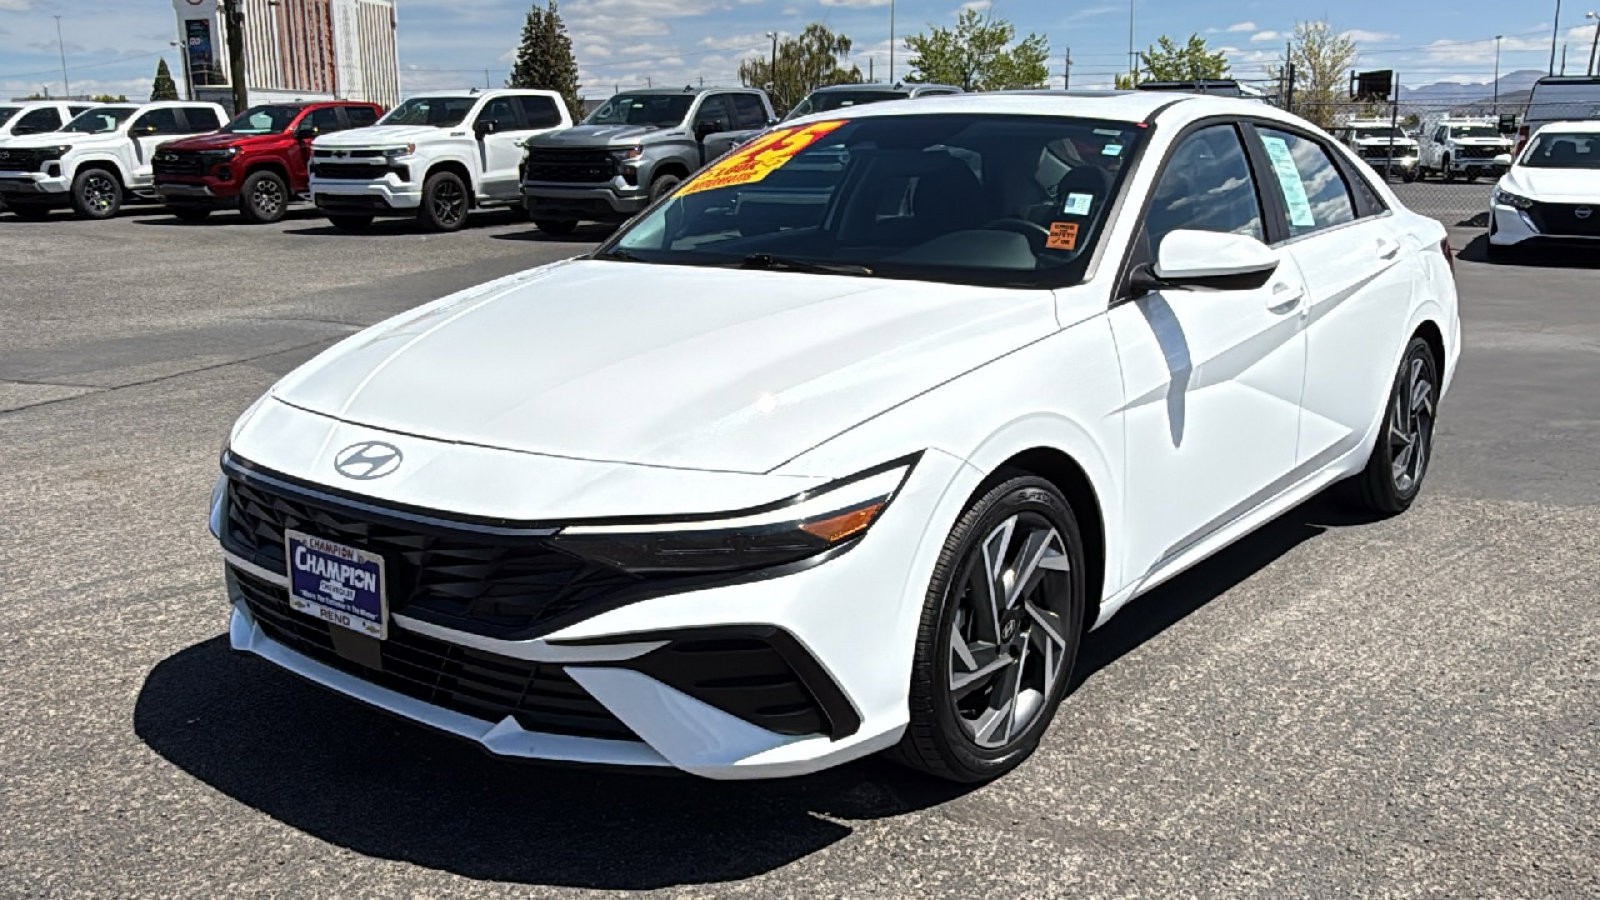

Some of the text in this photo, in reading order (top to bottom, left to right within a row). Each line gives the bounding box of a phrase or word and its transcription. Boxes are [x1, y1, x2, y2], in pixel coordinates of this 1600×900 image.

[309, 538, 353, 560] CHAMPION
[295, 545, 376, 593] CHAMPION
[320, 608, 351, 625] RENO
